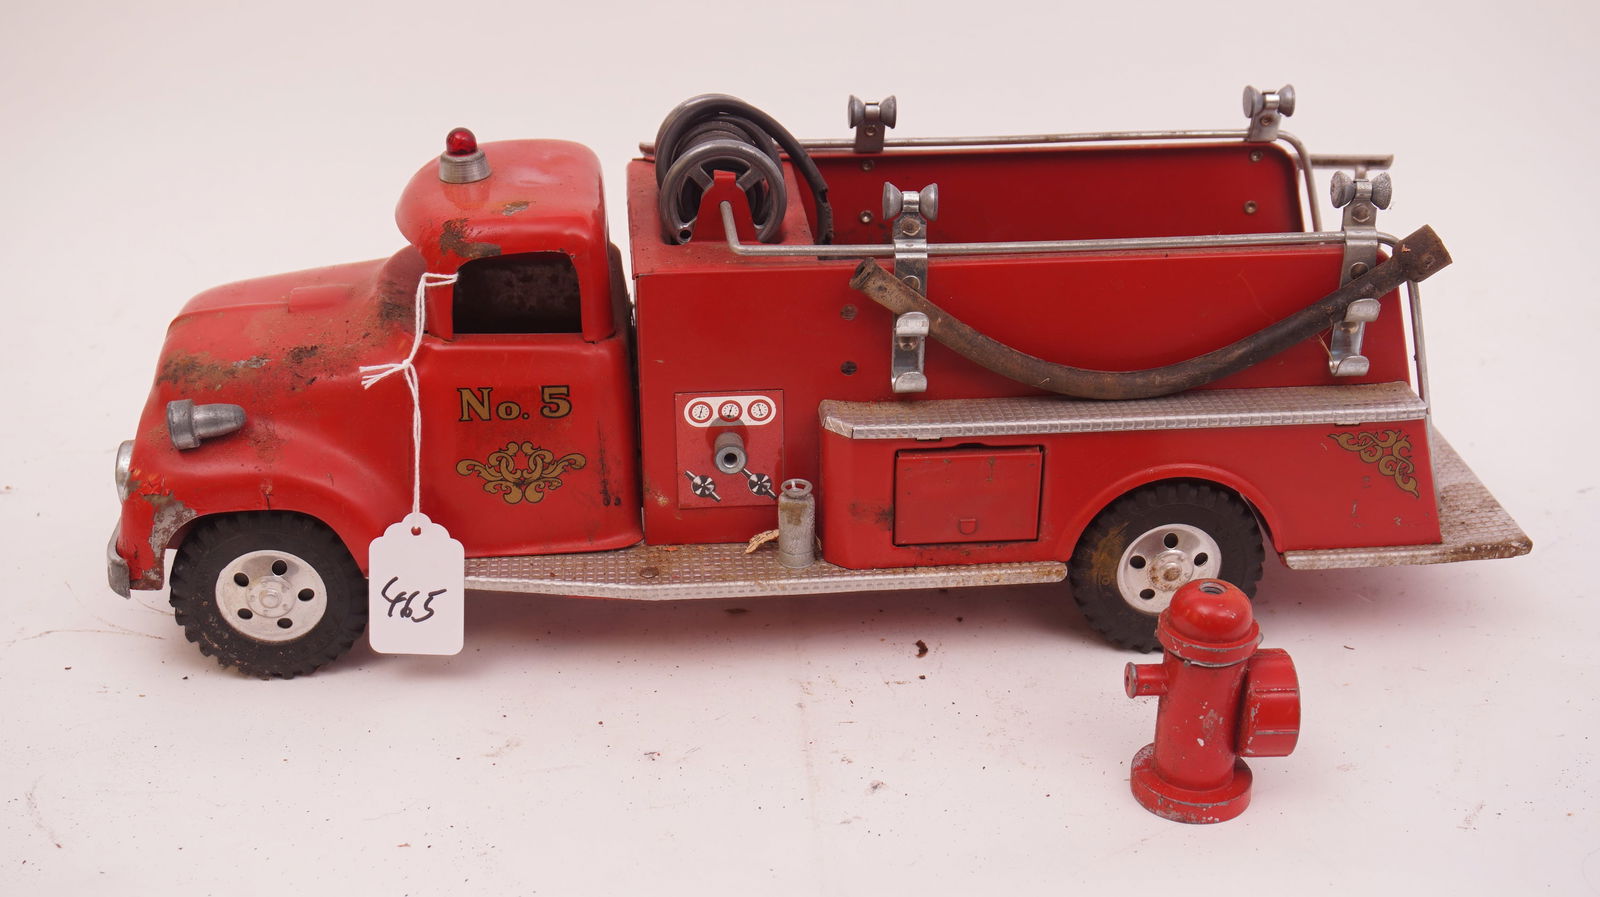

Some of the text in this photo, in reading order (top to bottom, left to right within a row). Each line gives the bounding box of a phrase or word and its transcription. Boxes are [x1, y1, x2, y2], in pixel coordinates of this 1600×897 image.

[456, 385, 572, 421] No. 5
[381, 576, 447, 622] 465
